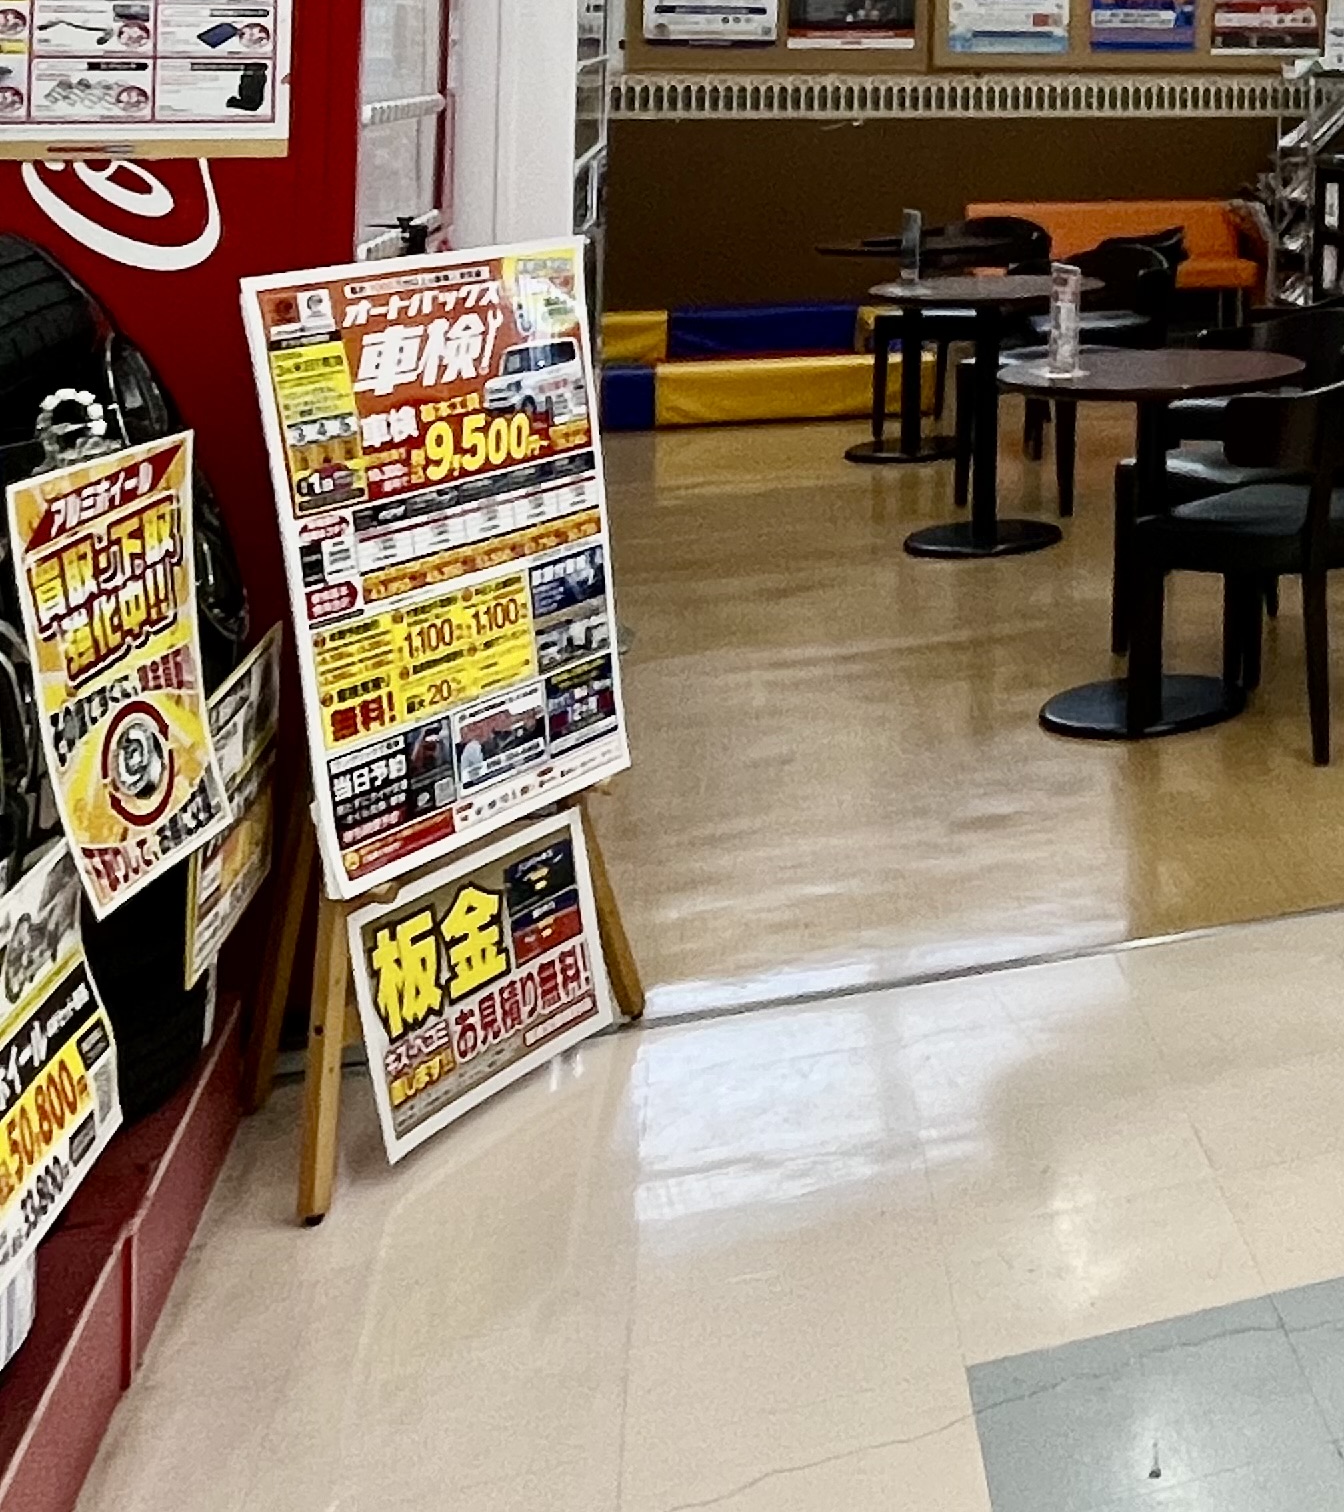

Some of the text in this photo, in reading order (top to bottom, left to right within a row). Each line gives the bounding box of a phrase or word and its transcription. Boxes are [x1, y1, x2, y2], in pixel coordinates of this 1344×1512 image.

[342, 281, 502, 329] オートバックス
[50, 462, 154, 538] アルミホイール
[372, 886, 507, 1039] 板金
[455, 941, 591, 1061] お見積り無料!
